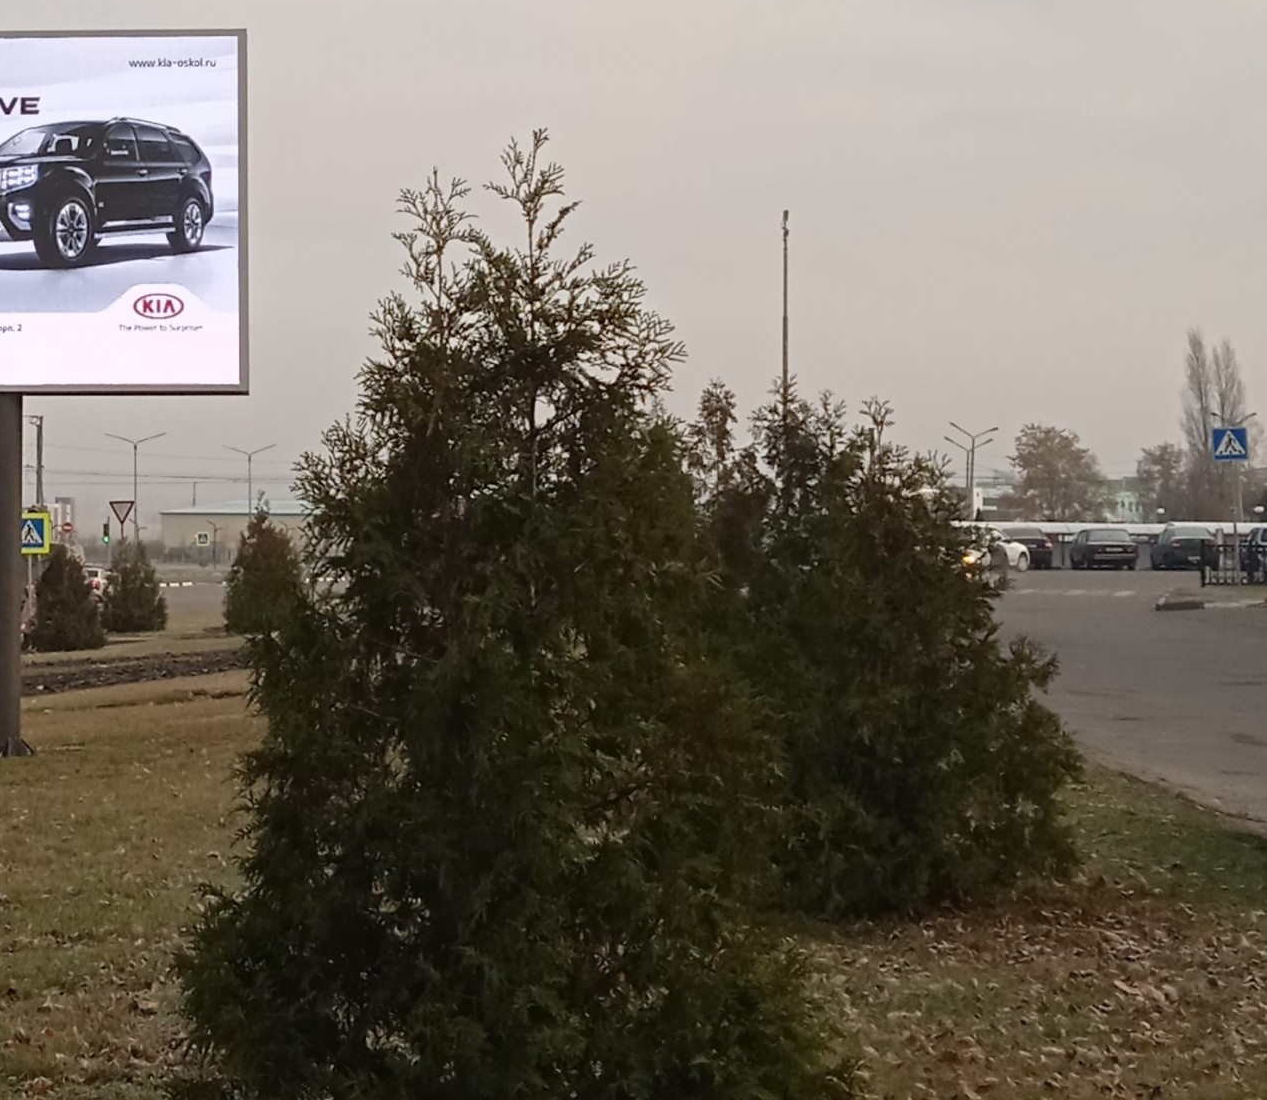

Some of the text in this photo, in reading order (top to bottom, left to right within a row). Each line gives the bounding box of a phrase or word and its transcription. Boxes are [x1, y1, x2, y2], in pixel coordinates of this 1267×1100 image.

[128, 57, 217, 68] www.kia-oskol.ru
[142, 299, 175, 313] KIA
[17, 324, 23, 332] 2
